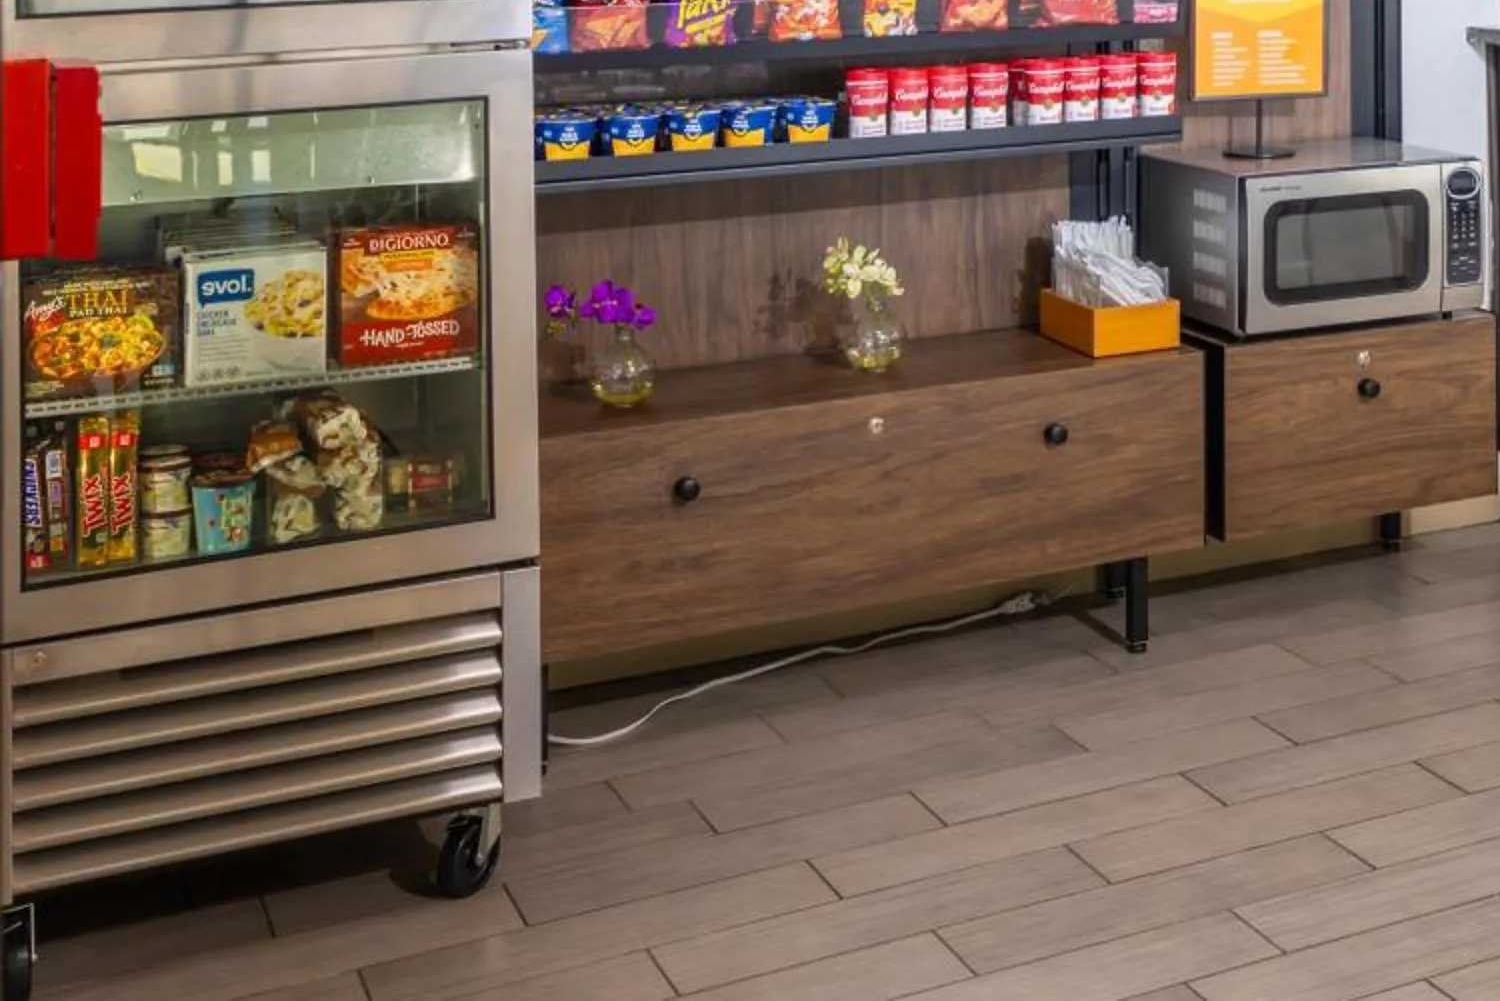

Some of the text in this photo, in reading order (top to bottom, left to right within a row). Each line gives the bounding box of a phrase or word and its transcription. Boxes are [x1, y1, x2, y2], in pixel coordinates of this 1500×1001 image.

[369, 233, 449, 253] DIGIORNO
[66, 290, 128, 310] THAI
[81, 474, 109, 537] TWIX
[111, 471, 135, 535] TWIX
